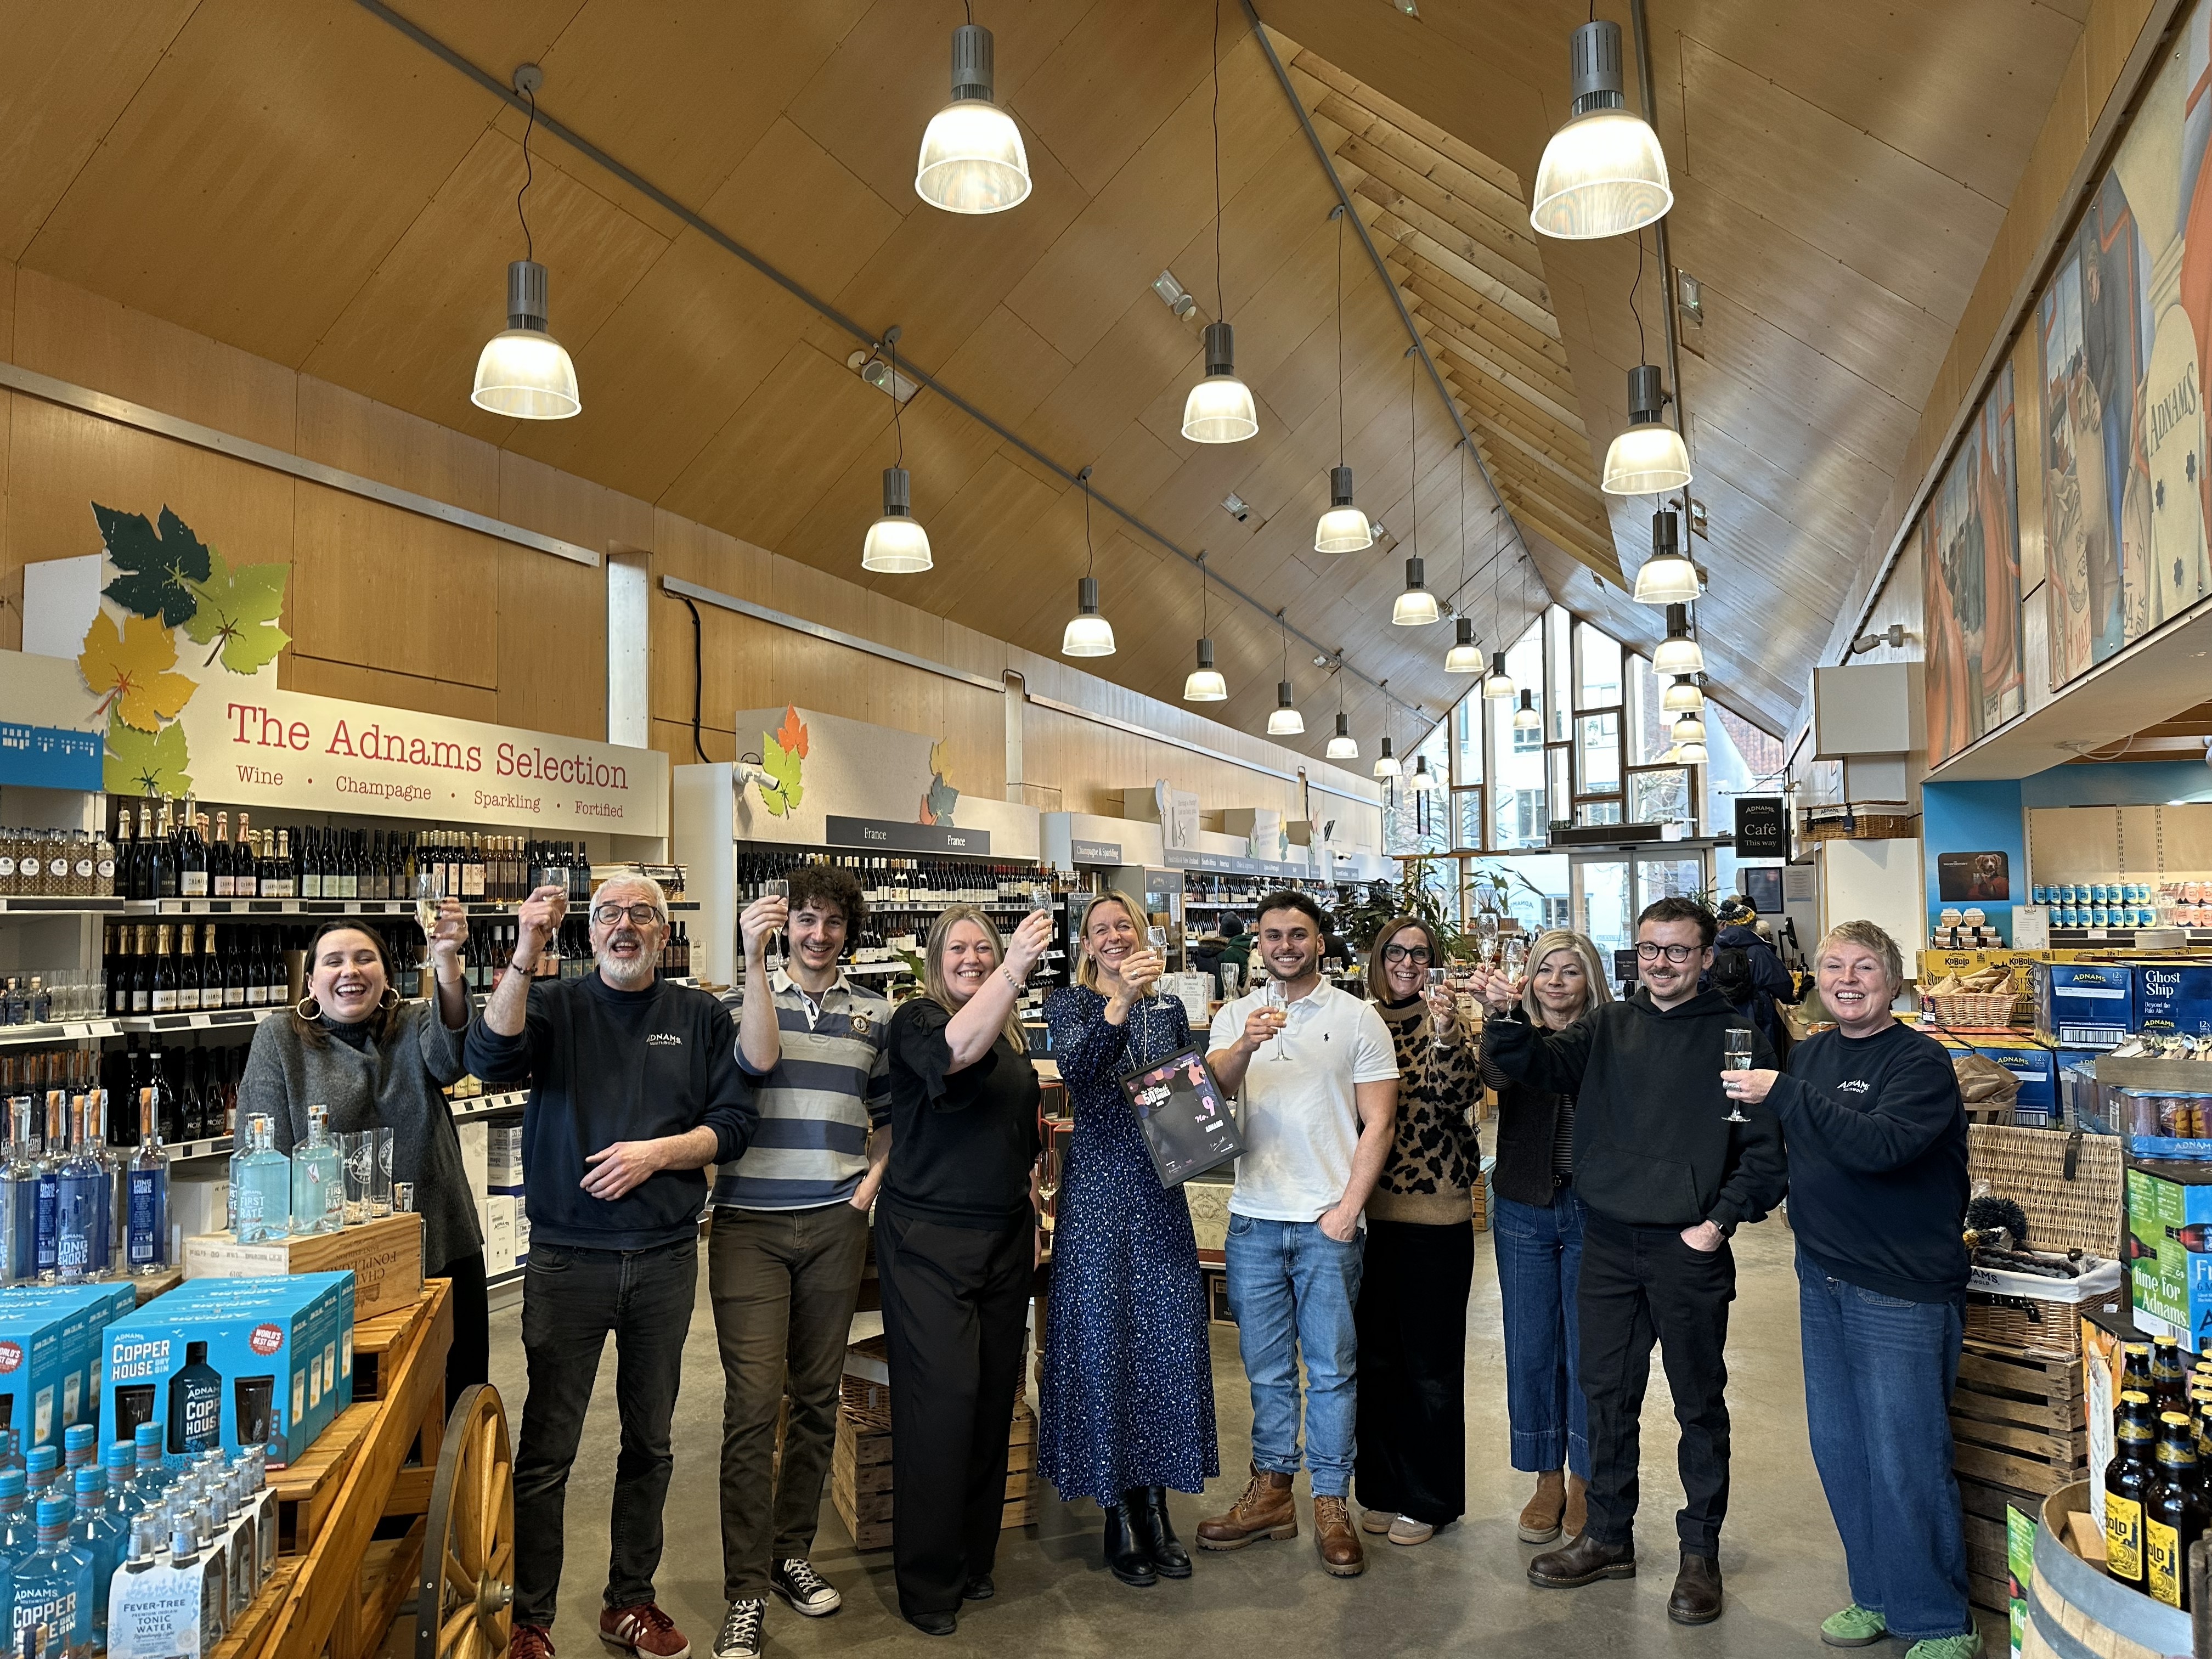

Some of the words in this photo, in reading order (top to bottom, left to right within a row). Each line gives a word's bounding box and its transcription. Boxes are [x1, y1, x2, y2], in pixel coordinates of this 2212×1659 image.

[2150, 361, 2196, 458] ADNAMS
[227, 703, 310, 751] The
[325, 720, 482, 772] Adnams
[496, 742, 628, 790] Selection
[236, 765, 283, 786] Wine
[336, 776, 431, 802] Champagne
[474, 790, 541, 813] Sparkling
[575, 800, 624, 818] Fortified
[1745, 805, 1775, 814] ADNAMS
[1745, 823, 1776, 836] Café
[865, 827, 887, 840] France
[947, 834, 966, 846] France
[1077, 845, 1098, 858] Champagne
[1099, 847, 1102, 856] &
[1103, 848, 1119, 860] Sparkling
[2073, 974, 2107, 983] ADNAMS
[2146, 970, 2180, 983] Ghost
[2146, 983, 2174, 998] Ship
[2144, 1019, 2175, 1028] ADNAMS
[646, 1033, 681, 1044] ADNAMS
[1997, 1057, 2029, 1065] ADNAMS
[1142, 1090, 1157, 1105] 50
[1153, 1083, 1168, 1094] Best
[1195, 1114, 1209, 1123] No.
[1202, 1096, 1215, 1116] 9
[134, 1179, 151, 1187] LONG
[240, 1197, 265, 1206] FIRST
[240, 1207, 263, 1218] RATE
[59, 1240, 88, 1255] LONG
[58, 1251, 88, 1266] SHORE
[61, 1268, 83, 1277] VODKA
[2135, 1266, 2158, 1292] time
[2162, 1276, 2180, 1301] for
[2142, 1290, 2190, 1328] Adnams.
[114, 1334, 144, 1342] ADNAMS
[253, 1335, 267, 1345] BEST
[256, 1328, 281, 1340] WORLD'S
[112, 1340, 170, 1363] COPPER
[155, 1357, 170, 1366] DRY
[112, 1360, 154, 1380] HOUSE
[155, 1365, 169, 1374] GIN
[14, 1589, 58, 1601] ADNAMS
[13, 1592, 76, 1629] COPPER
[123, 1599, 185, 1612] FEVER-TREE
[60, 1611, 76, 1626] DRY
[138, 1615, 171, 1625] TONIC
[59, 1620, 76, 1635] GIN
[137, 1623, 172, 1633] WATER
